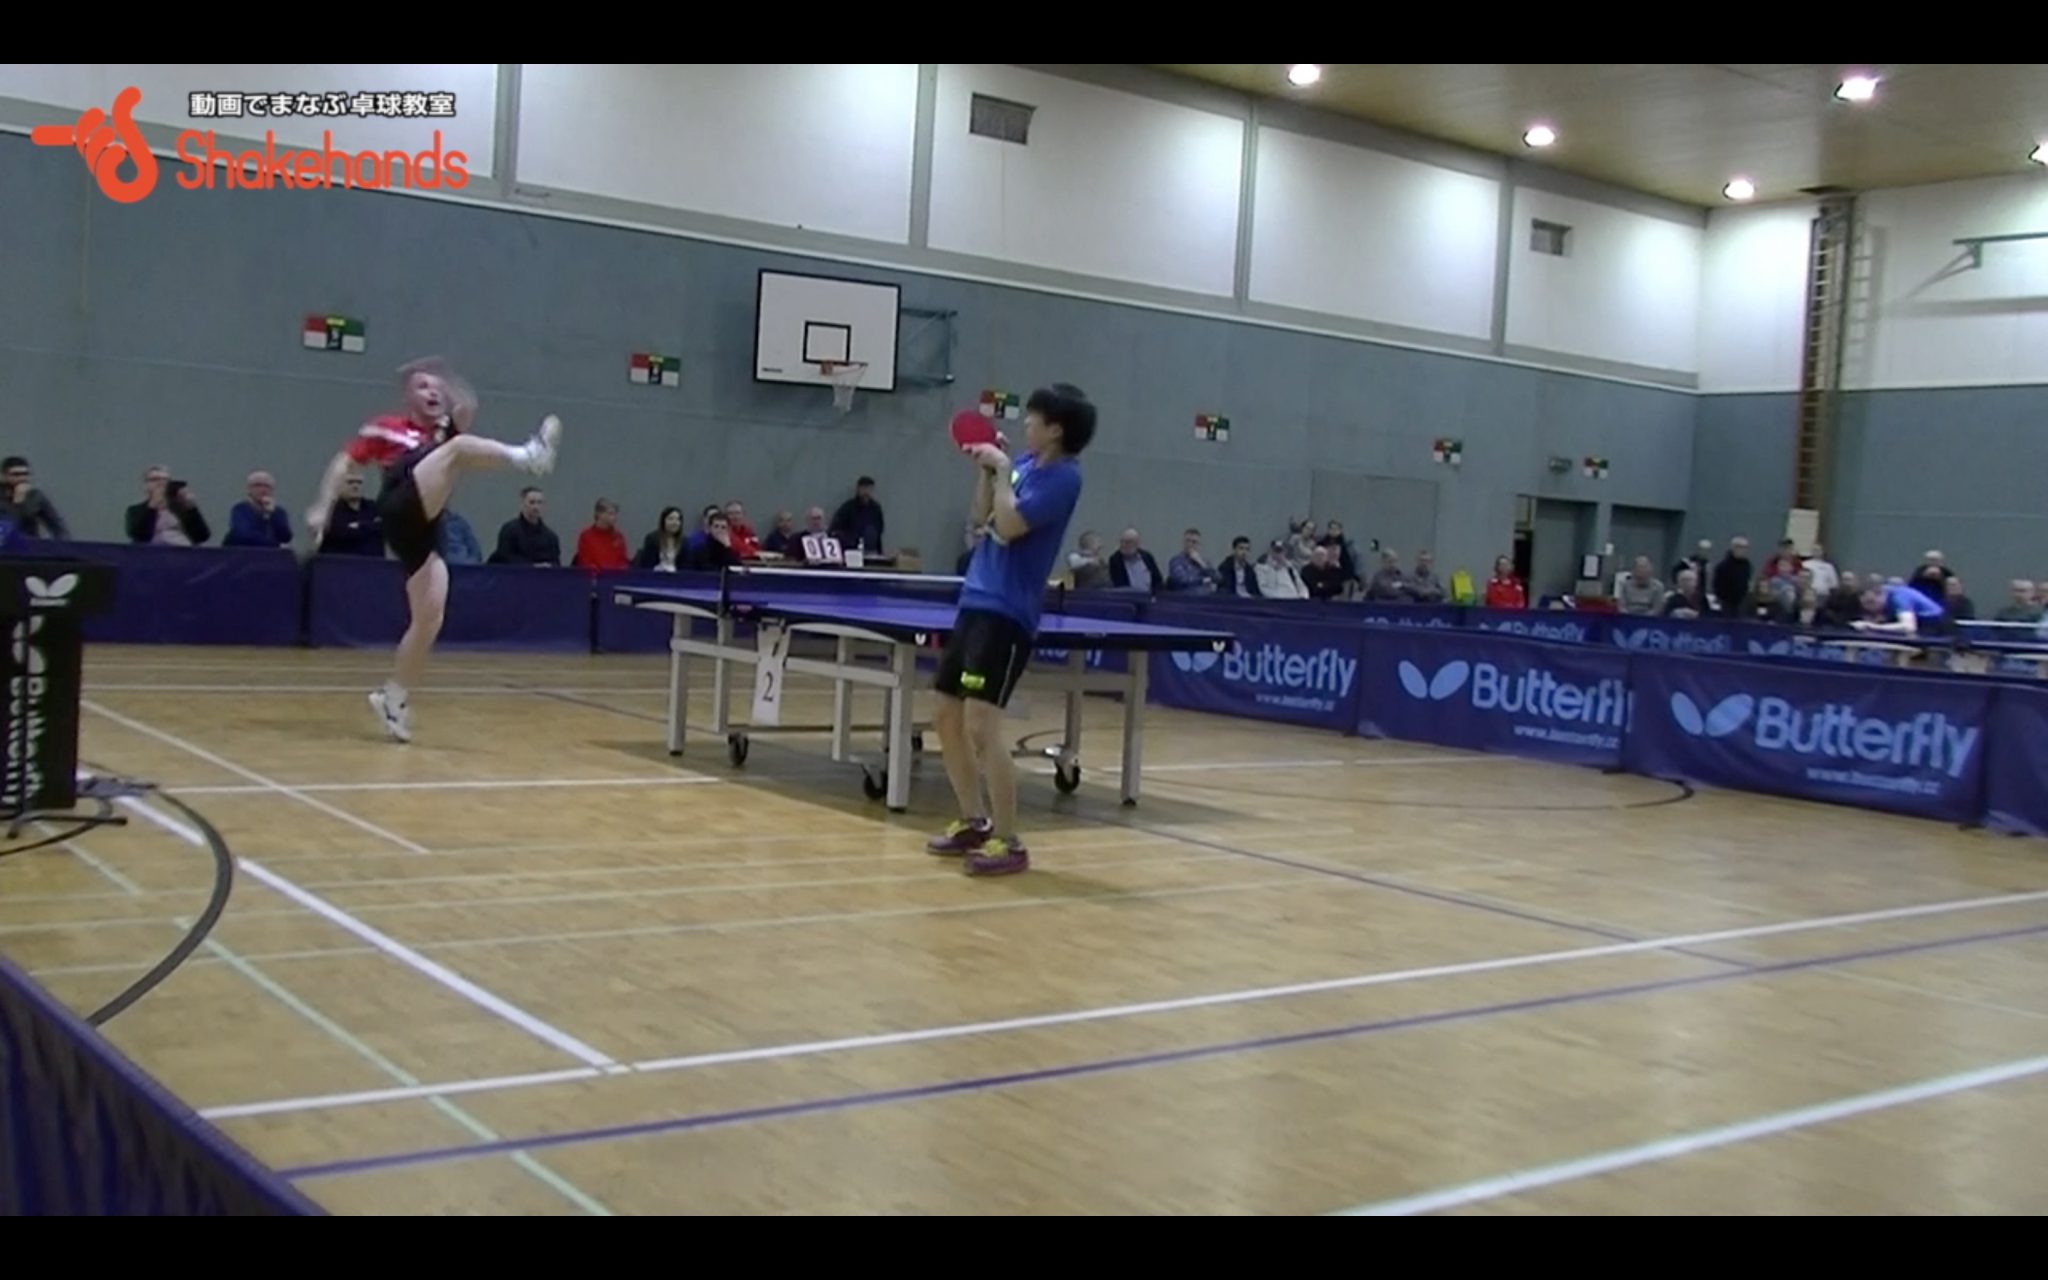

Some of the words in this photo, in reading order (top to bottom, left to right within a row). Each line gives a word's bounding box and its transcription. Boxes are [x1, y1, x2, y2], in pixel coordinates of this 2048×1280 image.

[826, 541, 837, 557] 2
[763, 671, 774, 702] 2
[1223, 642, 1357, 698] Butterfly
[1755, 696, 1980, 777] Butterfly
